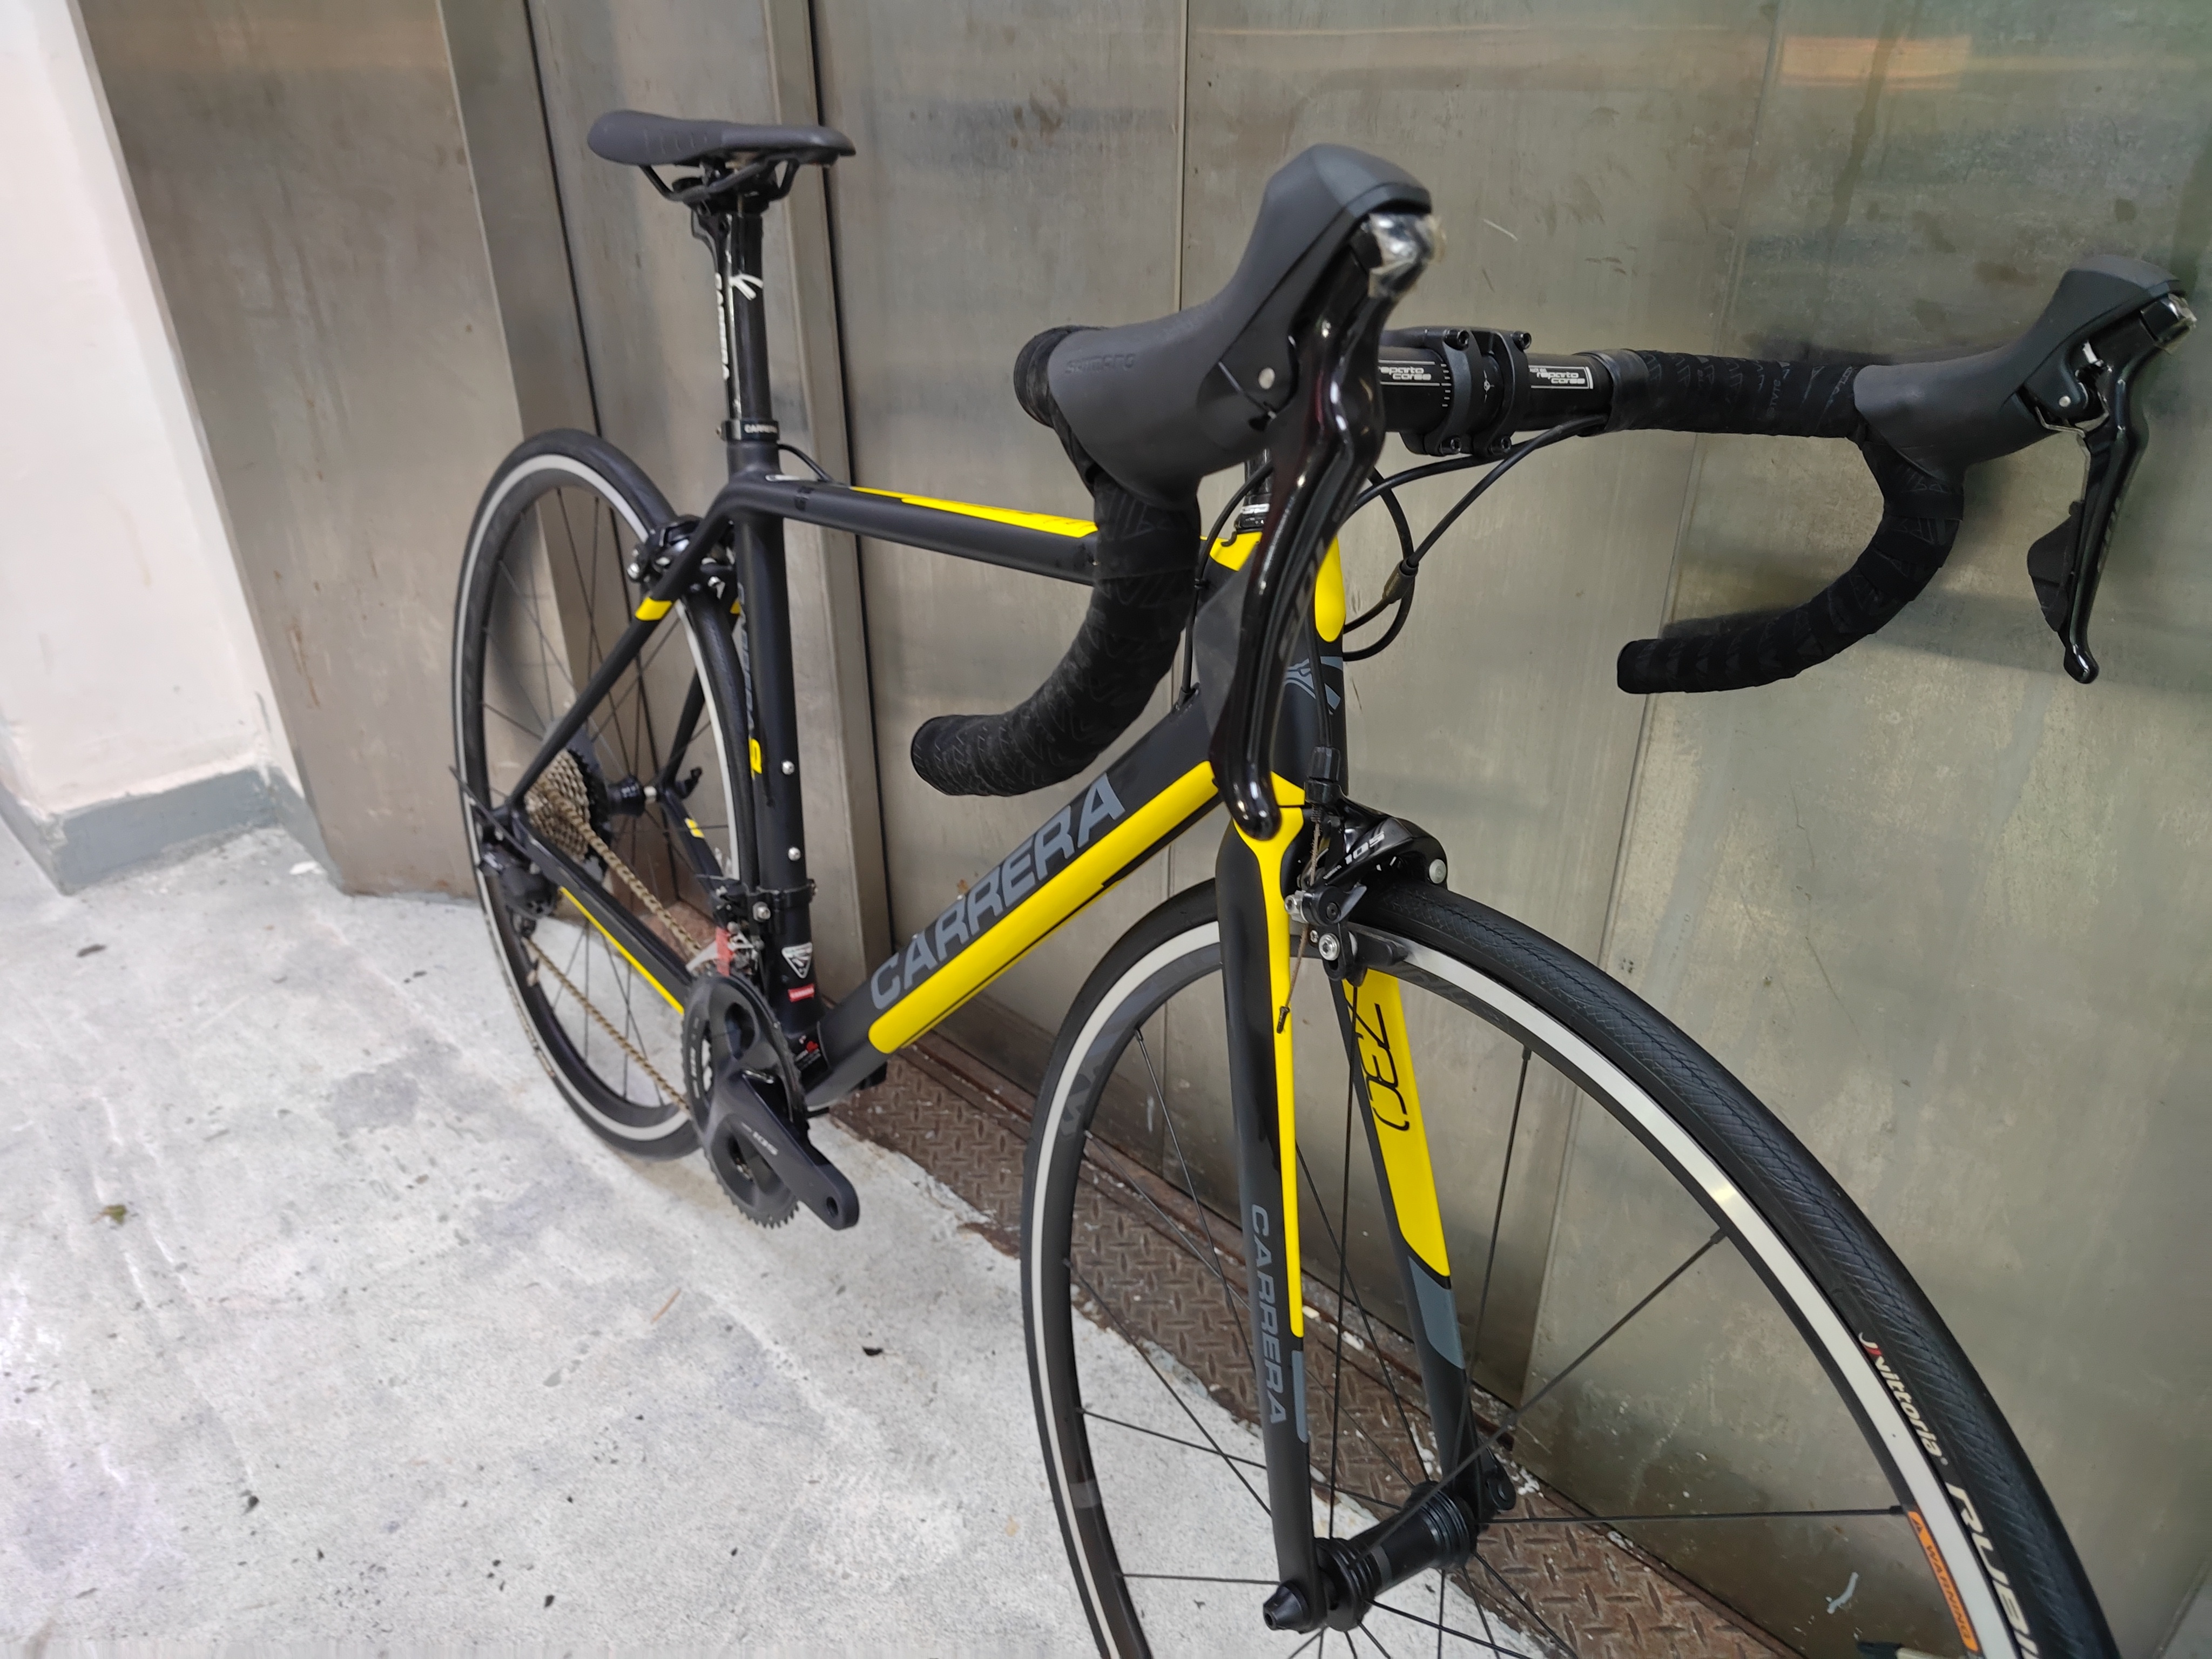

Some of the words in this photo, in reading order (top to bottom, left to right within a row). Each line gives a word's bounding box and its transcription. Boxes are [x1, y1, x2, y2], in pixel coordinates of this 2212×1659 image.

[1536, 372, 1579, 380] reparto
[871, 772, 1125, 1009] CARRERA
[1345, 831, 1385, 865] 105
[1252, 1204, 1286, 1424] CARRERA
[1875, 1355, 1943, 1456] vittoria
[1944, 1481, 2040, 1659] RUBI
